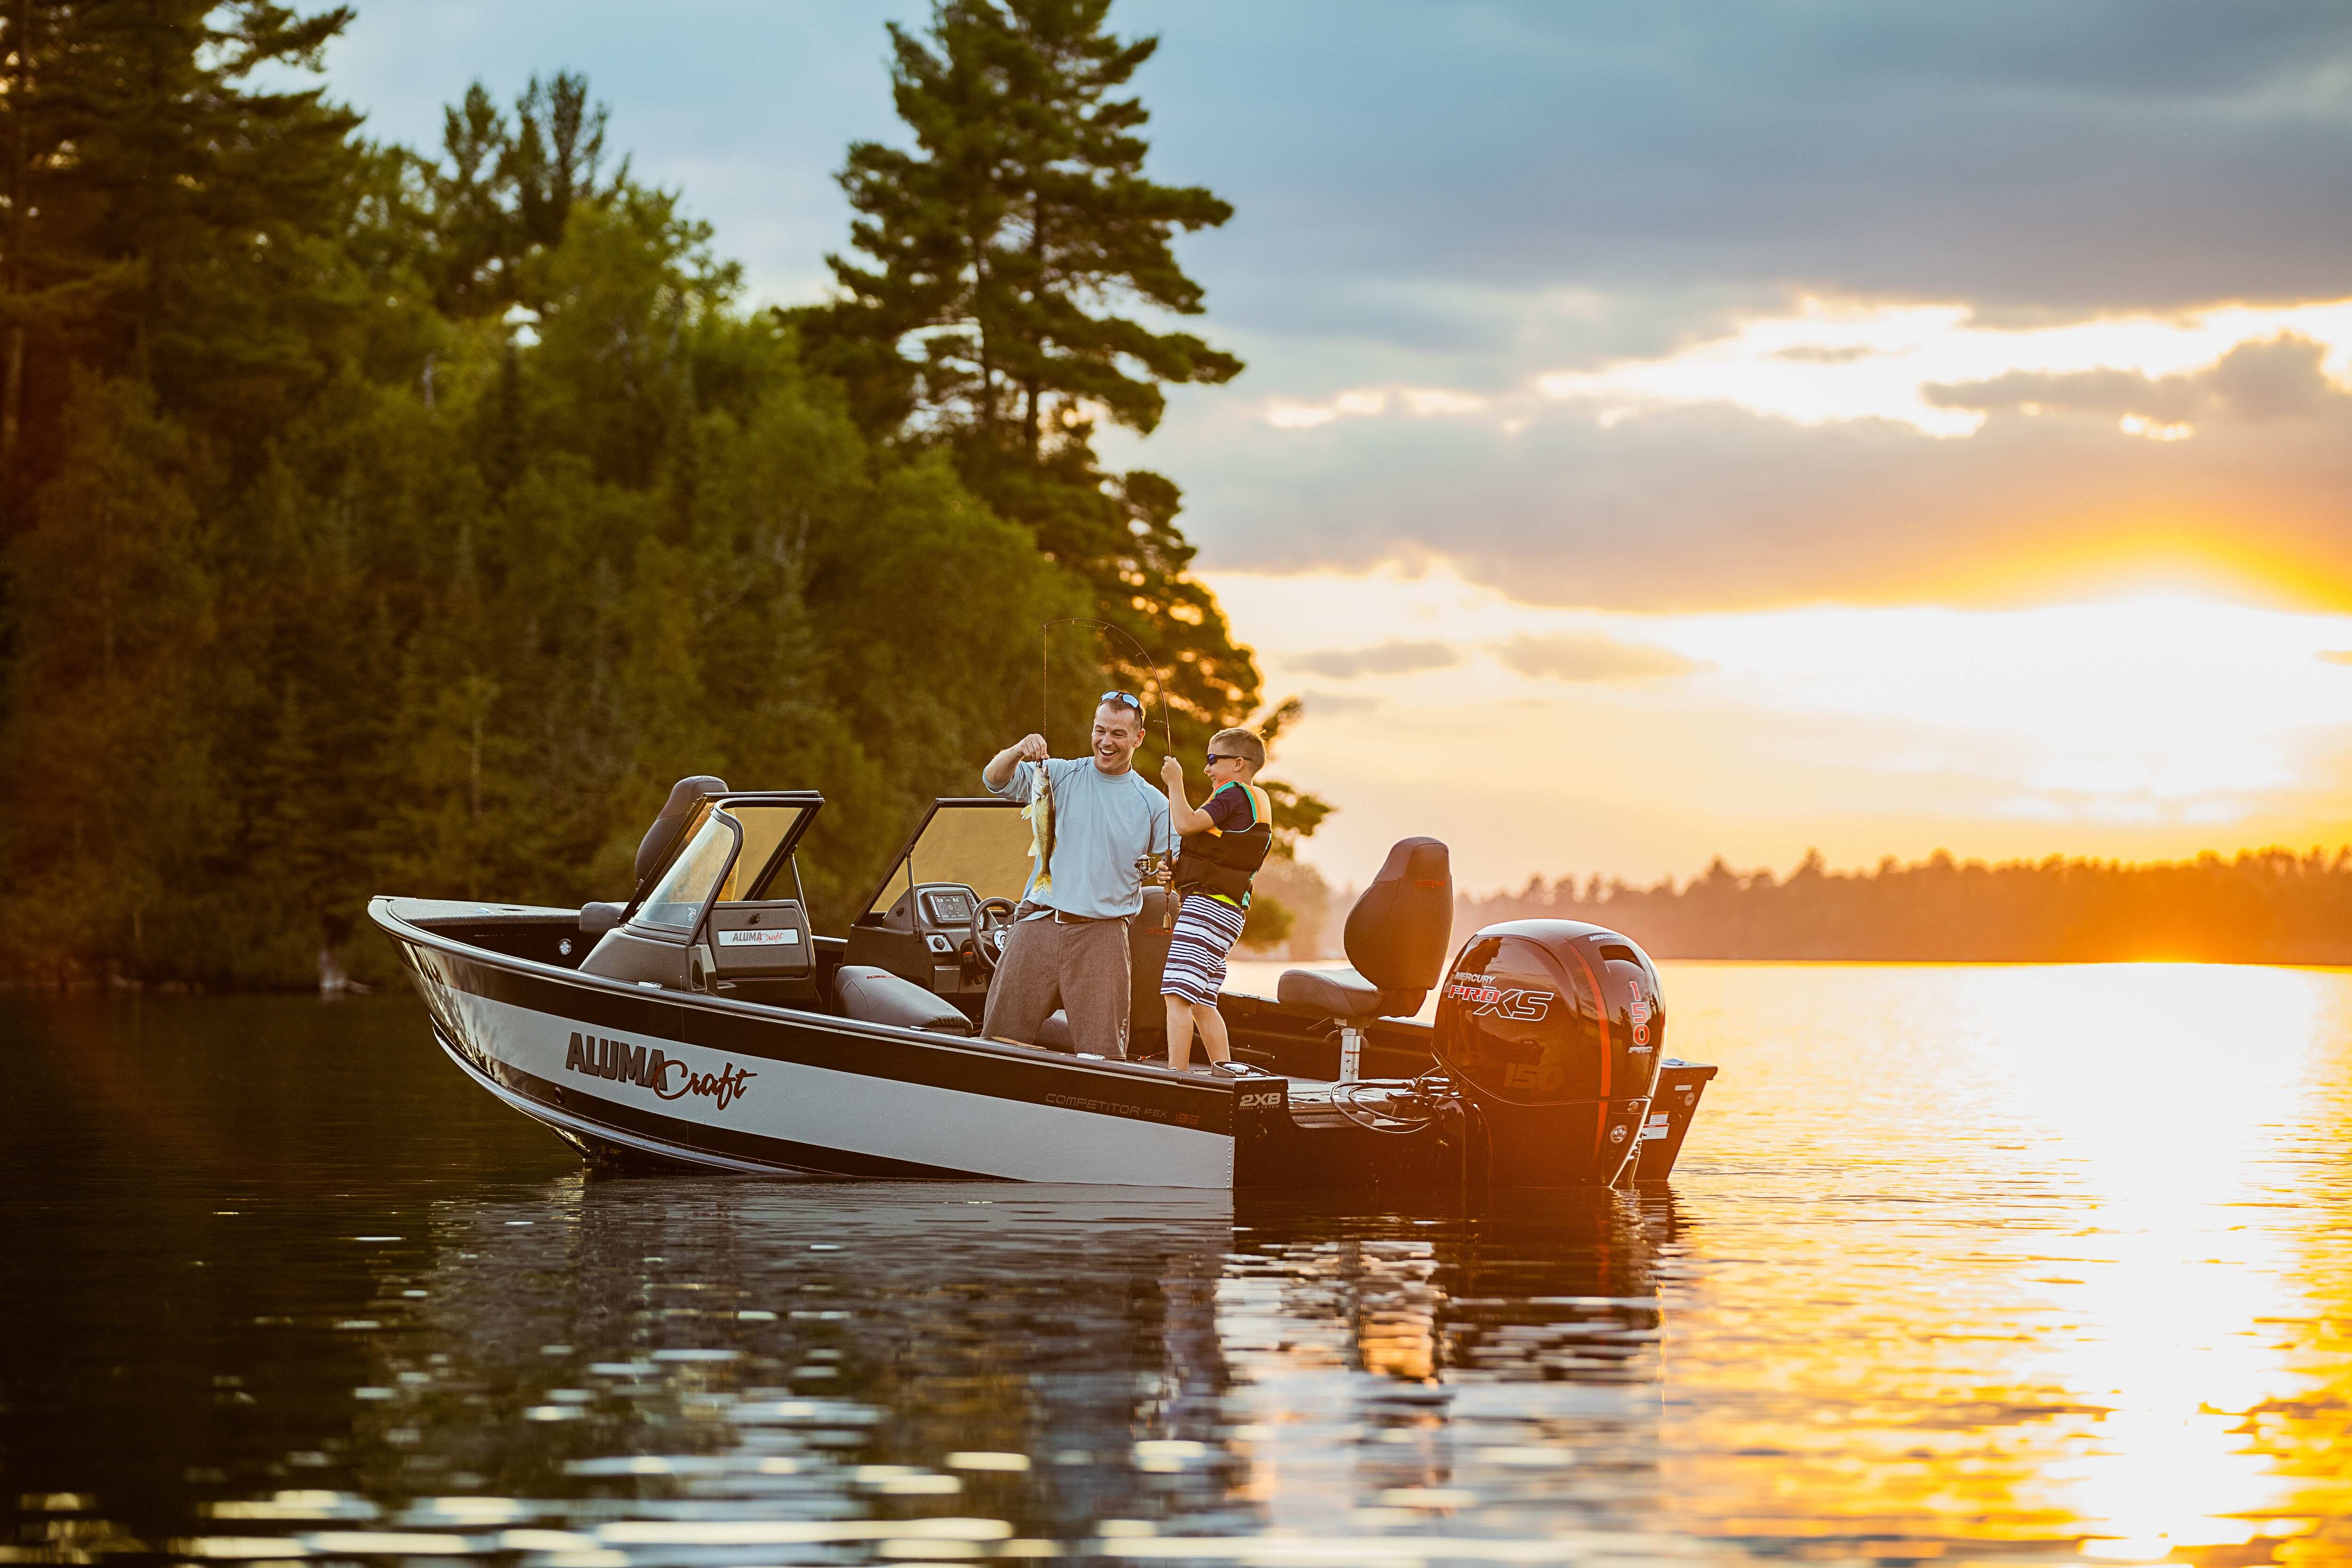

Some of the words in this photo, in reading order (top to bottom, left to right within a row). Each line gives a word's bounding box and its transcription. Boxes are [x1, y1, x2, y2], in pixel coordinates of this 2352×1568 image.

[930, 896, 940, 918] LOWRANCE
[1454, 972, 1496, 984] MERCURY
[1448, 985, 1501, 1004] PRO
[1473, 988, 1554, 1021] XS
[1629, 981, 1650, 1046] 150
[1503, 1062, 1565, 1091] 150
[1046, 1093, 1141, 1116] COMPETITOR
[1144, 1109, 1168, 1118] FSX
[1240, 1092, 1281, 1106] 2XB
